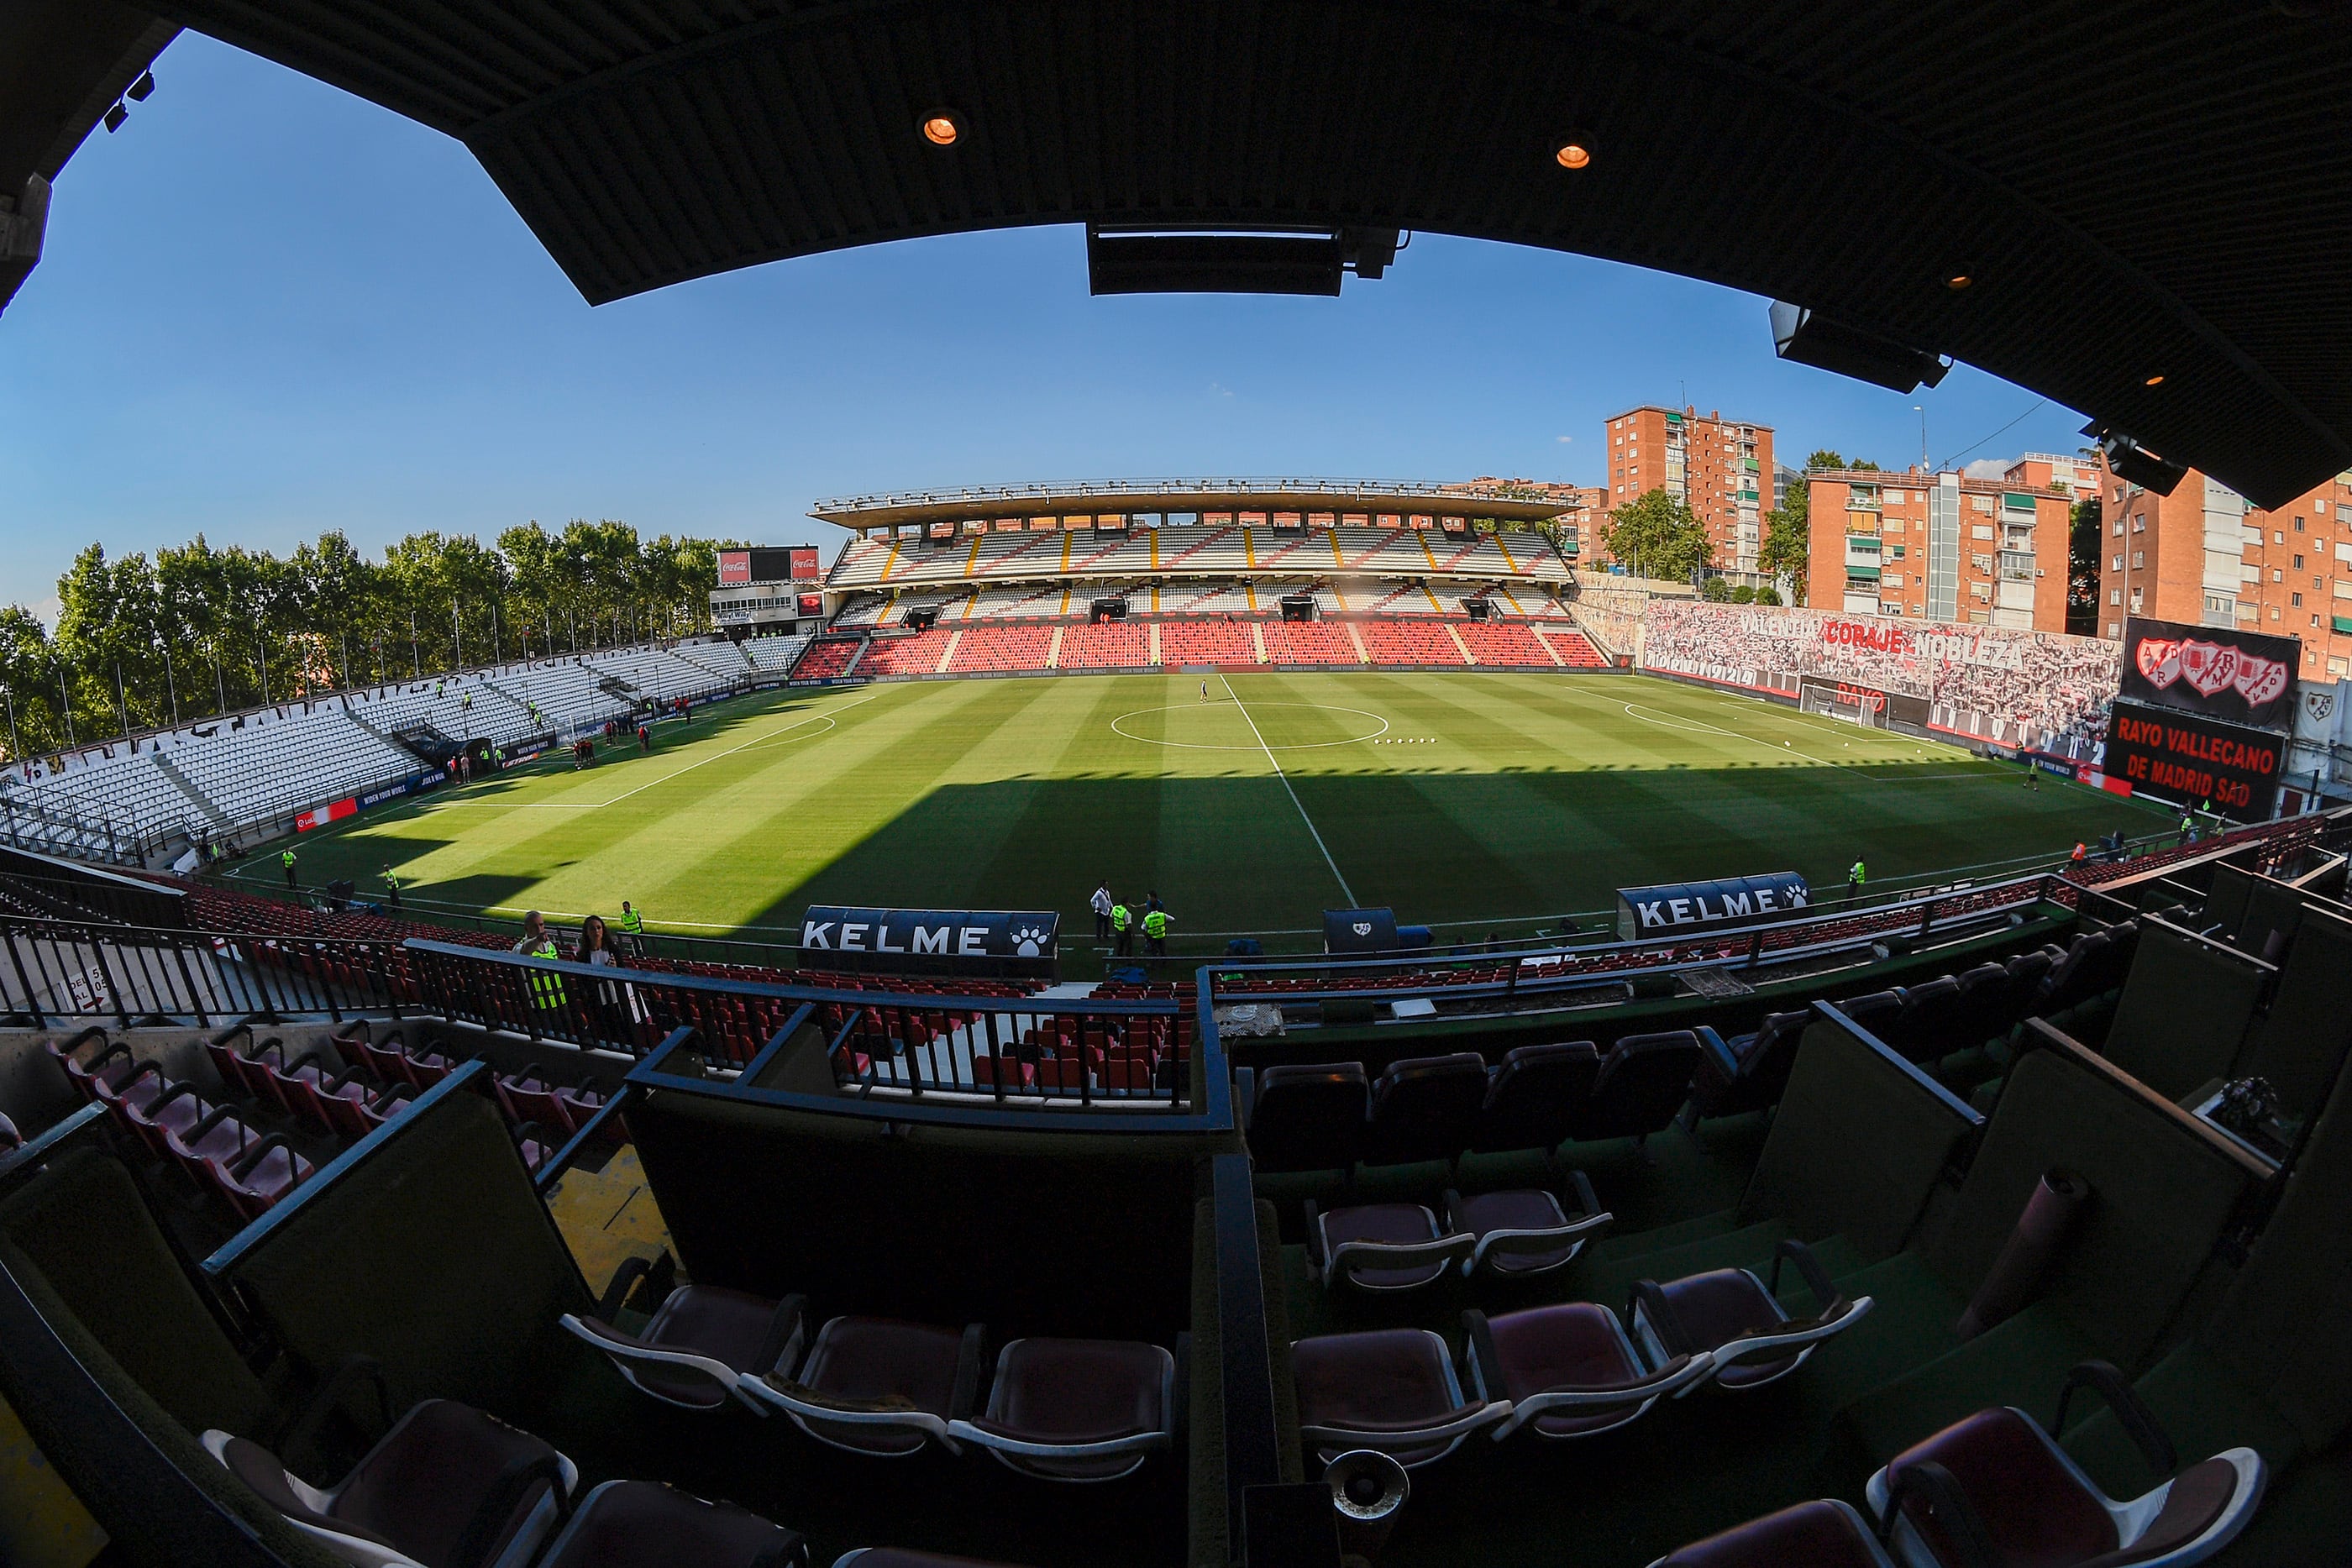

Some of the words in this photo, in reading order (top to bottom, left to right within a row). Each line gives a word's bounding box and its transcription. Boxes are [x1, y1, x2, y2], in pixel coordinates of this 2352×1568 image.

[1825, 621, 1903, 653] CORAJE
[1914, 632, 2024, 670] NOBLEZA
[2143, 647, 2152, 658] A
[2223, 653, 2234, 670] R
[2157, 671, 2166, 682] R
[2211, 674, 2223, 685] M
[1836, 683, 1886, 712] RAYO
[2118, 717, 2162, 747] RAYO
[2167, 727, 2274, 774] VALLECANO
[2127, 754, 2149, 779] DE
[2150, 760, 2213, 797] MADRID
[2216, 778, 2250, 807] SAD
[363, 794, 378, 805] WIDEN
[379, 789, 391, 801] YOUR
[1637, 889, 1778, 928] KELME
[801, 920, 990, 956] KELME
